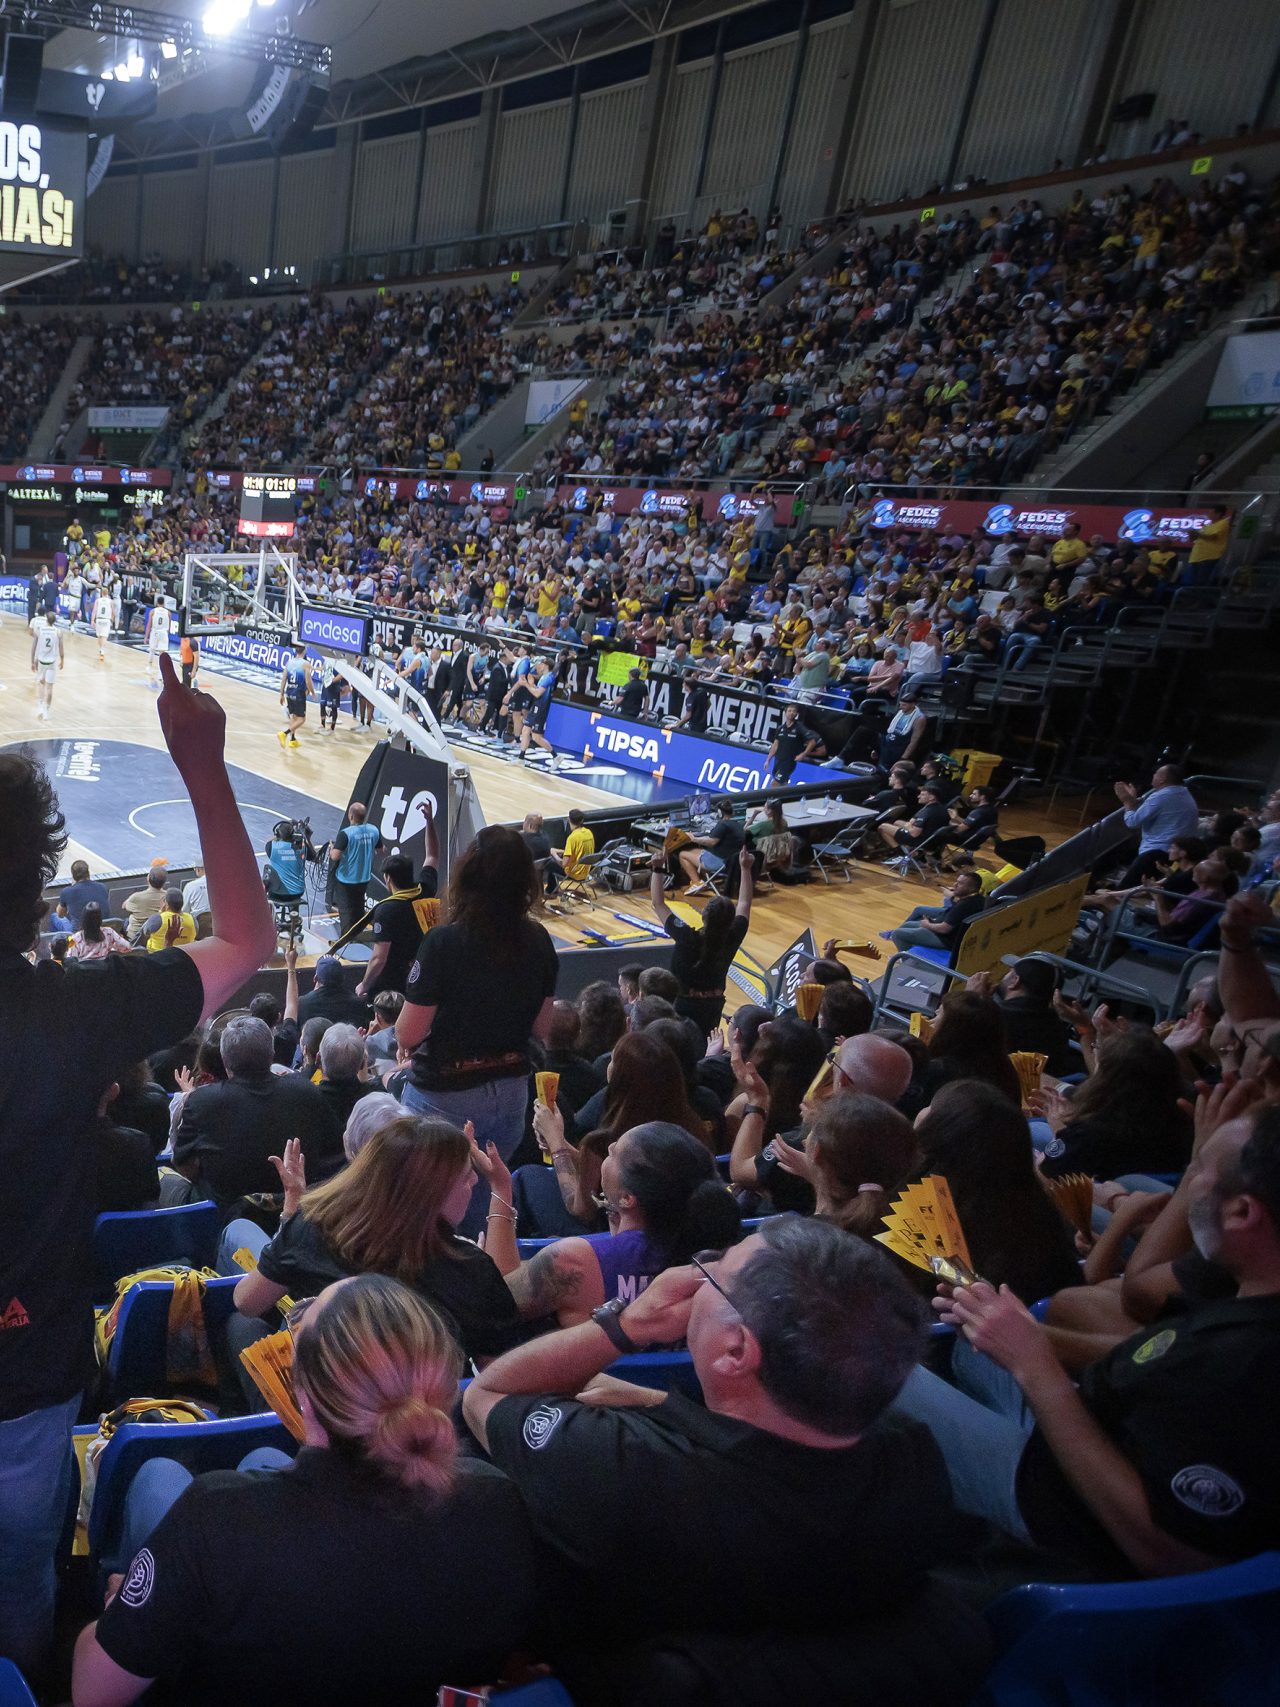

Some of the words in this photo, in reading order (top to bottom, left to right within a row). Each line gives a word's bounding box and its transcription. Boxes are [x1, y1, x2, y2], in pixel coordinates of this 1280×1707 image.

[899, 507, 941, 518] FEDES
[1019, 511, 1067, 523] FEDES
[246, 629, 282, 646] endesa
[304, 618, 361, 646] endesa
[205, 635, 279, 668] MENSAJERÍA
[596, 725, 659, 763] TIPSA
